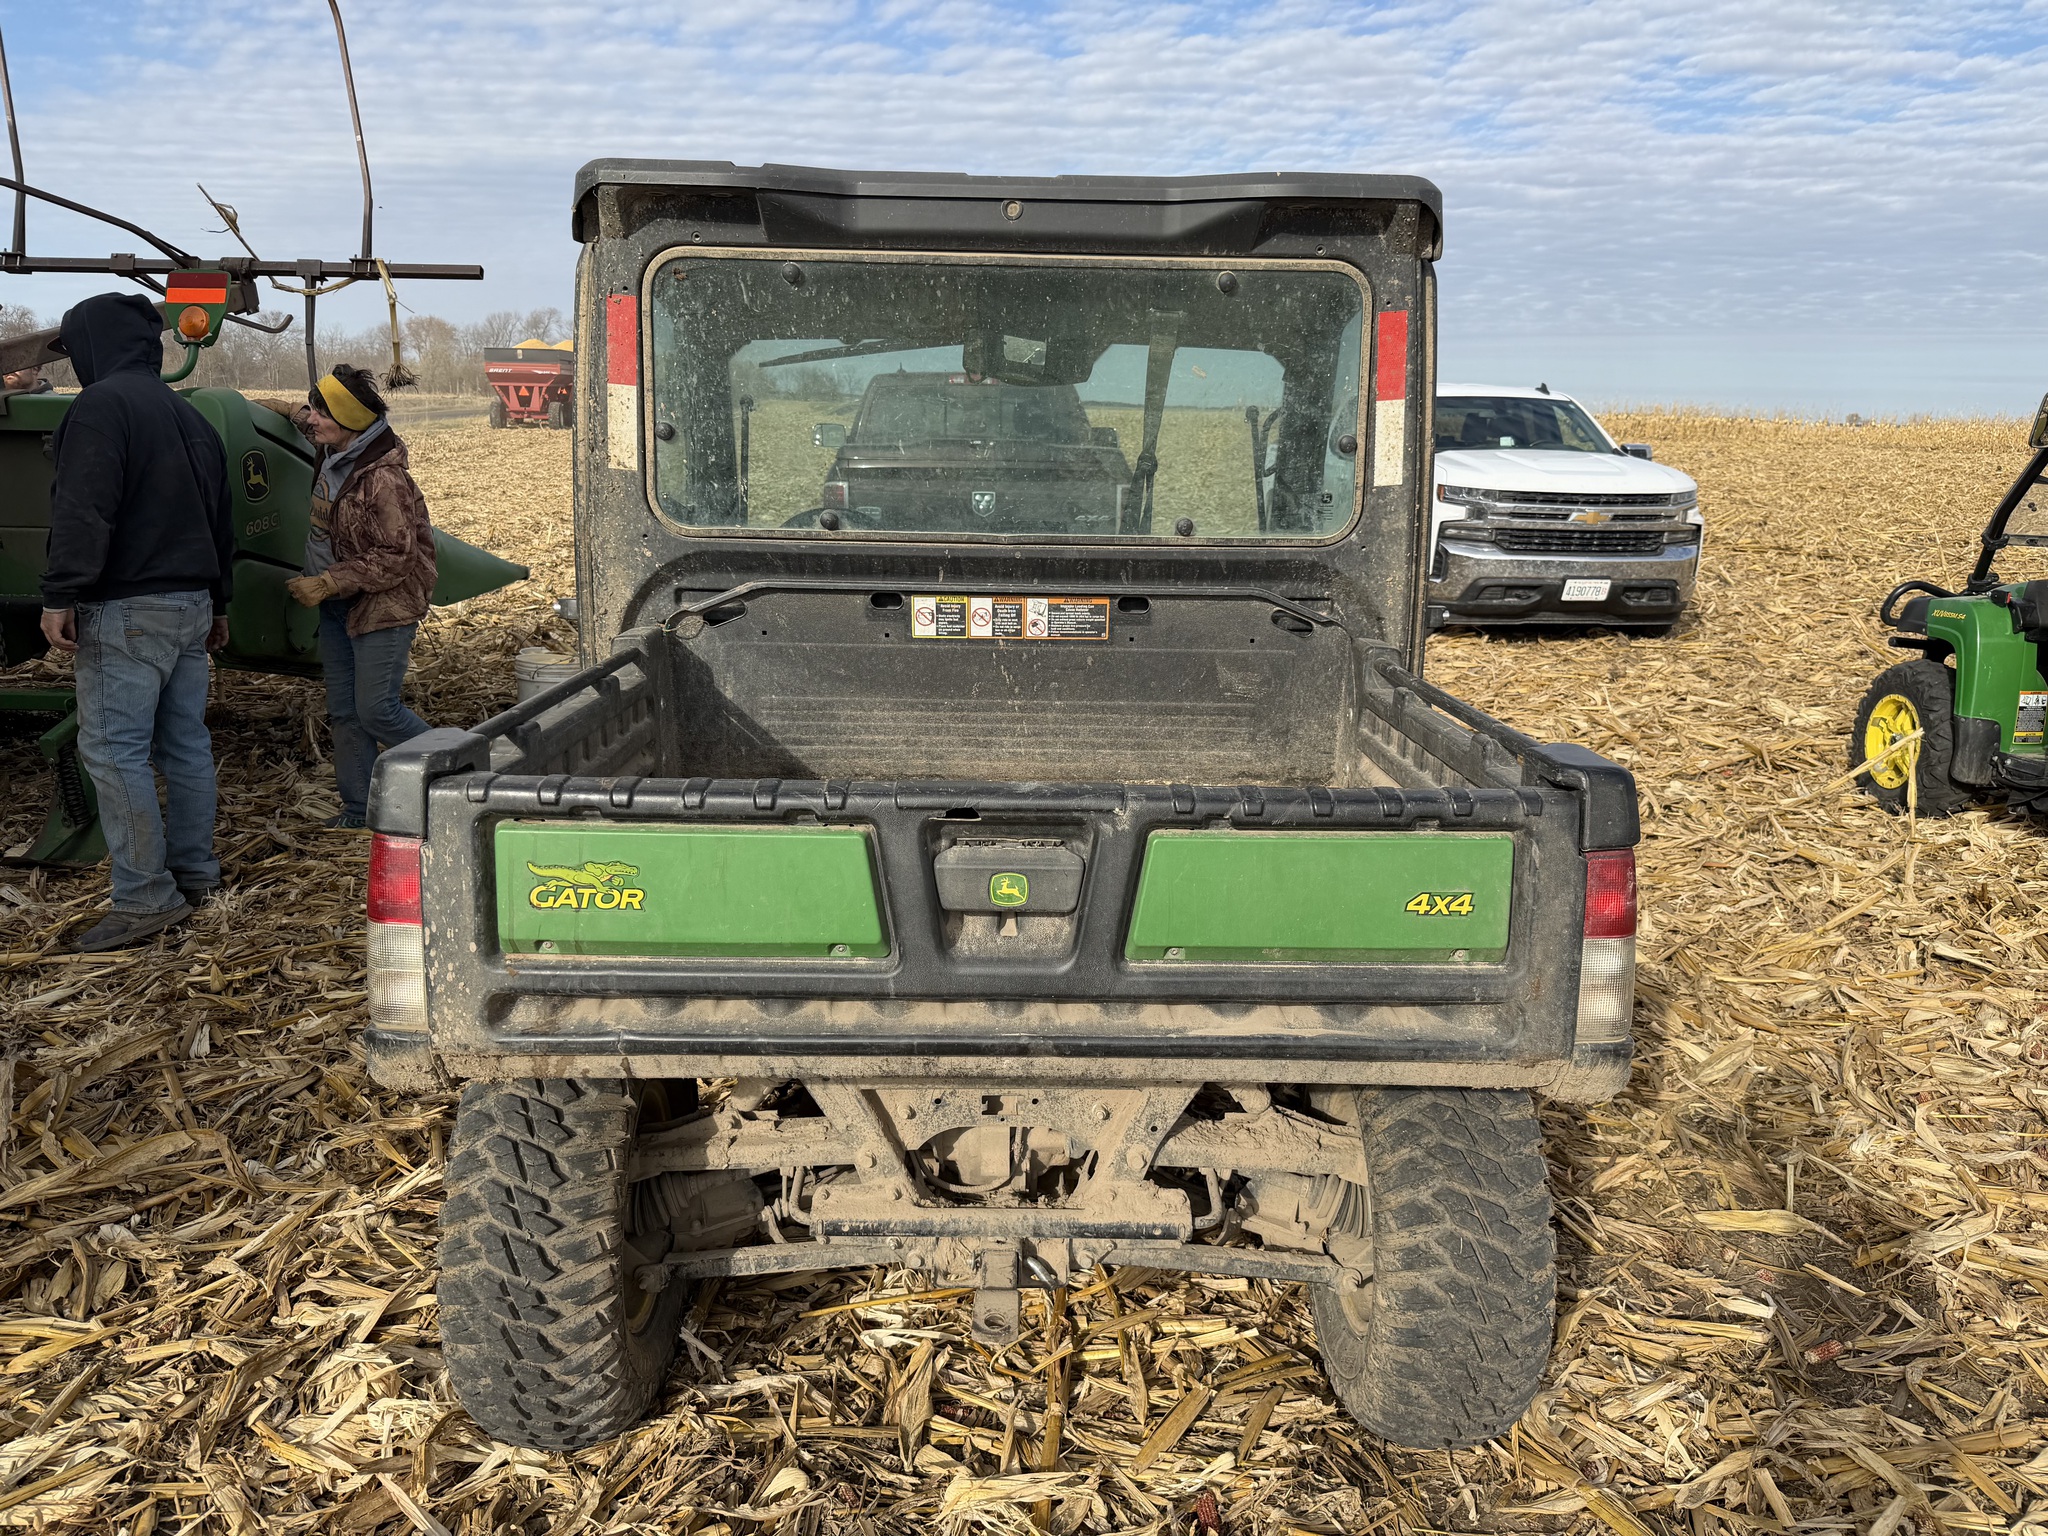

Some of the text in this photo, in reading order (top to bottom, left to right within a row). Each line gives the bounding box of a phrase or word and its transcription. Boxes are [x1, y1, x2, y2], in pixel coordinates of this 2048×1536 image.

[246, 512, 279, 536] 608C
[1566, 586, 1602, 596] 4190778
[529, 885, 645, 911] GATOR
[1405, 892, 1475, 916] 4x4
